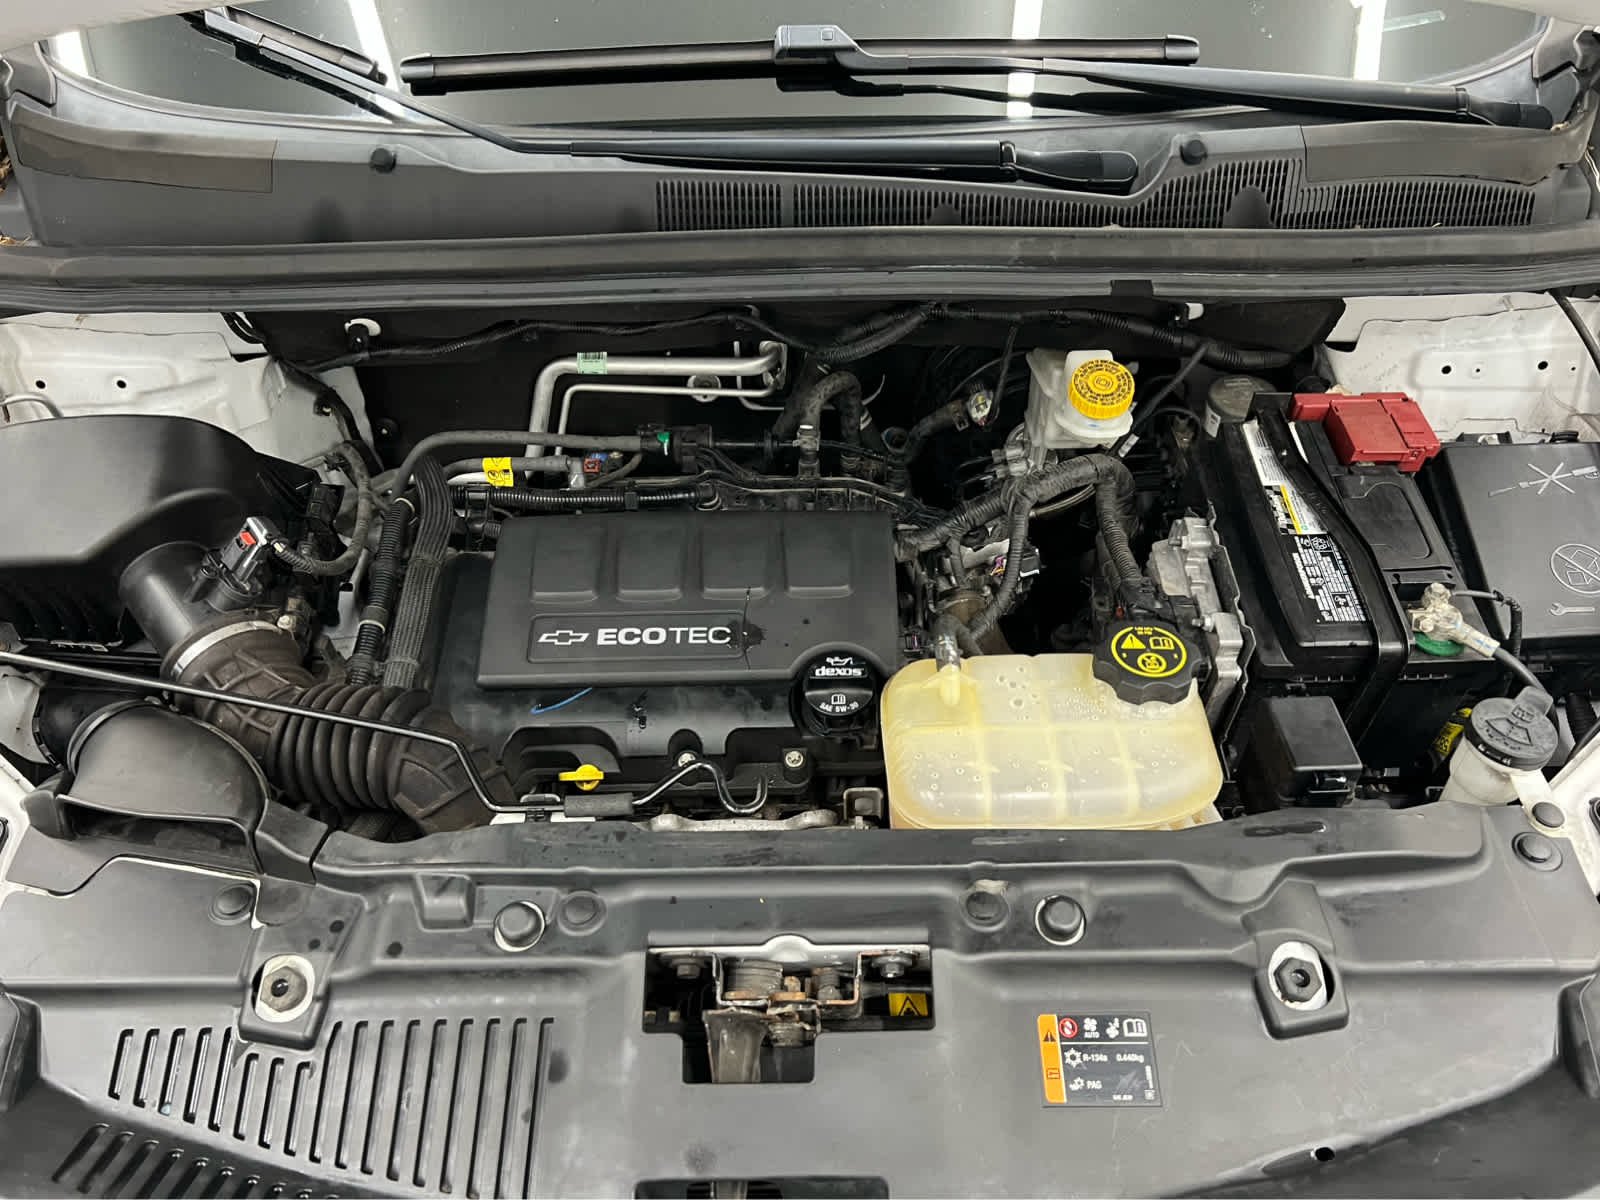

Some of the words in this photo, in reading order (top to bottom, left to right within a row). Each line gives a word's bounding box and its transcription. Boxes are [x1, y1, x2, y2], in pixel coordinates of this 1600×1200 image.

[597, 627, 732, 645] ECOTEC
[815, 666, 863, 676] dexos
[819, 702, 832, 712] SAE
[1086, 1080, 1102, 1089] PAG
